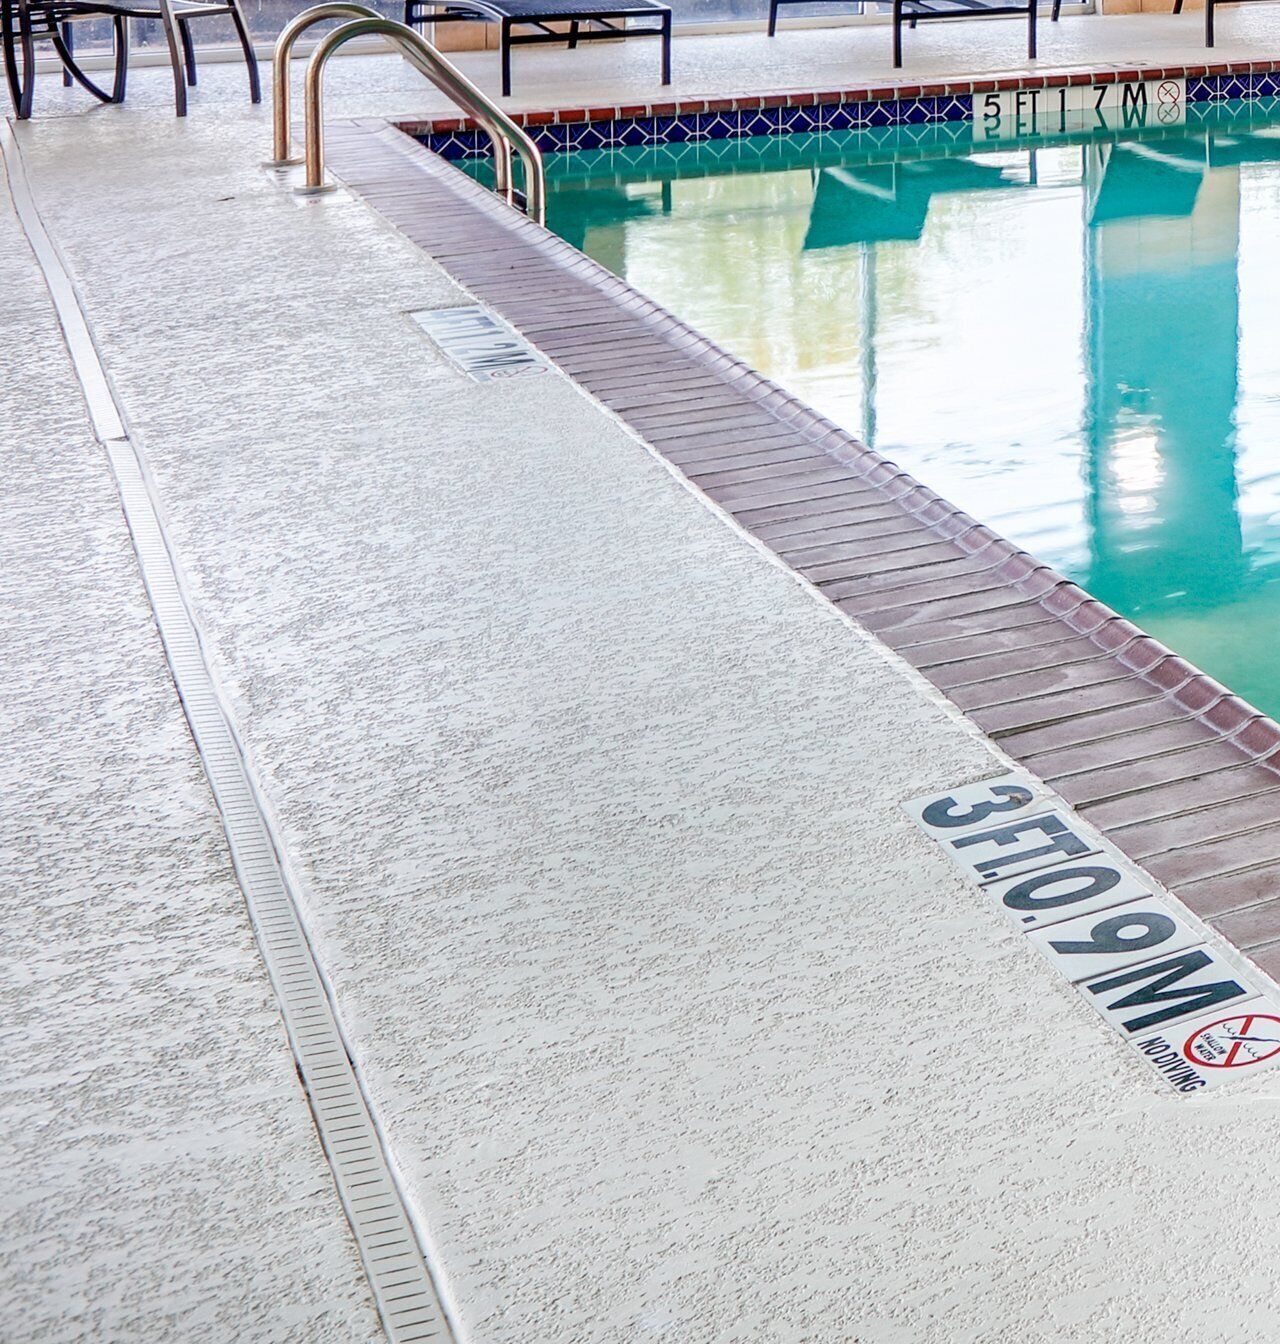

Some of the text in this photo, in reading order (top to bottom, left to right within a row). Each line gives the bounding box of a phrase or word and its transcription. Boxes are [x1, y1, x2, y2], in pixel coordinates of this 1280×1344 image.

[984, 94, 1000, 117] 5
[1016, 90, 1040, 116] FT
[1122, 83, 1147, 106] M
[466, 352, 536, 369] M
[921, 785, 1034, 828] 3
[1087, 950, 1247, 1034] M
[1137, 1036, 1207, 1093] NO DIVING
